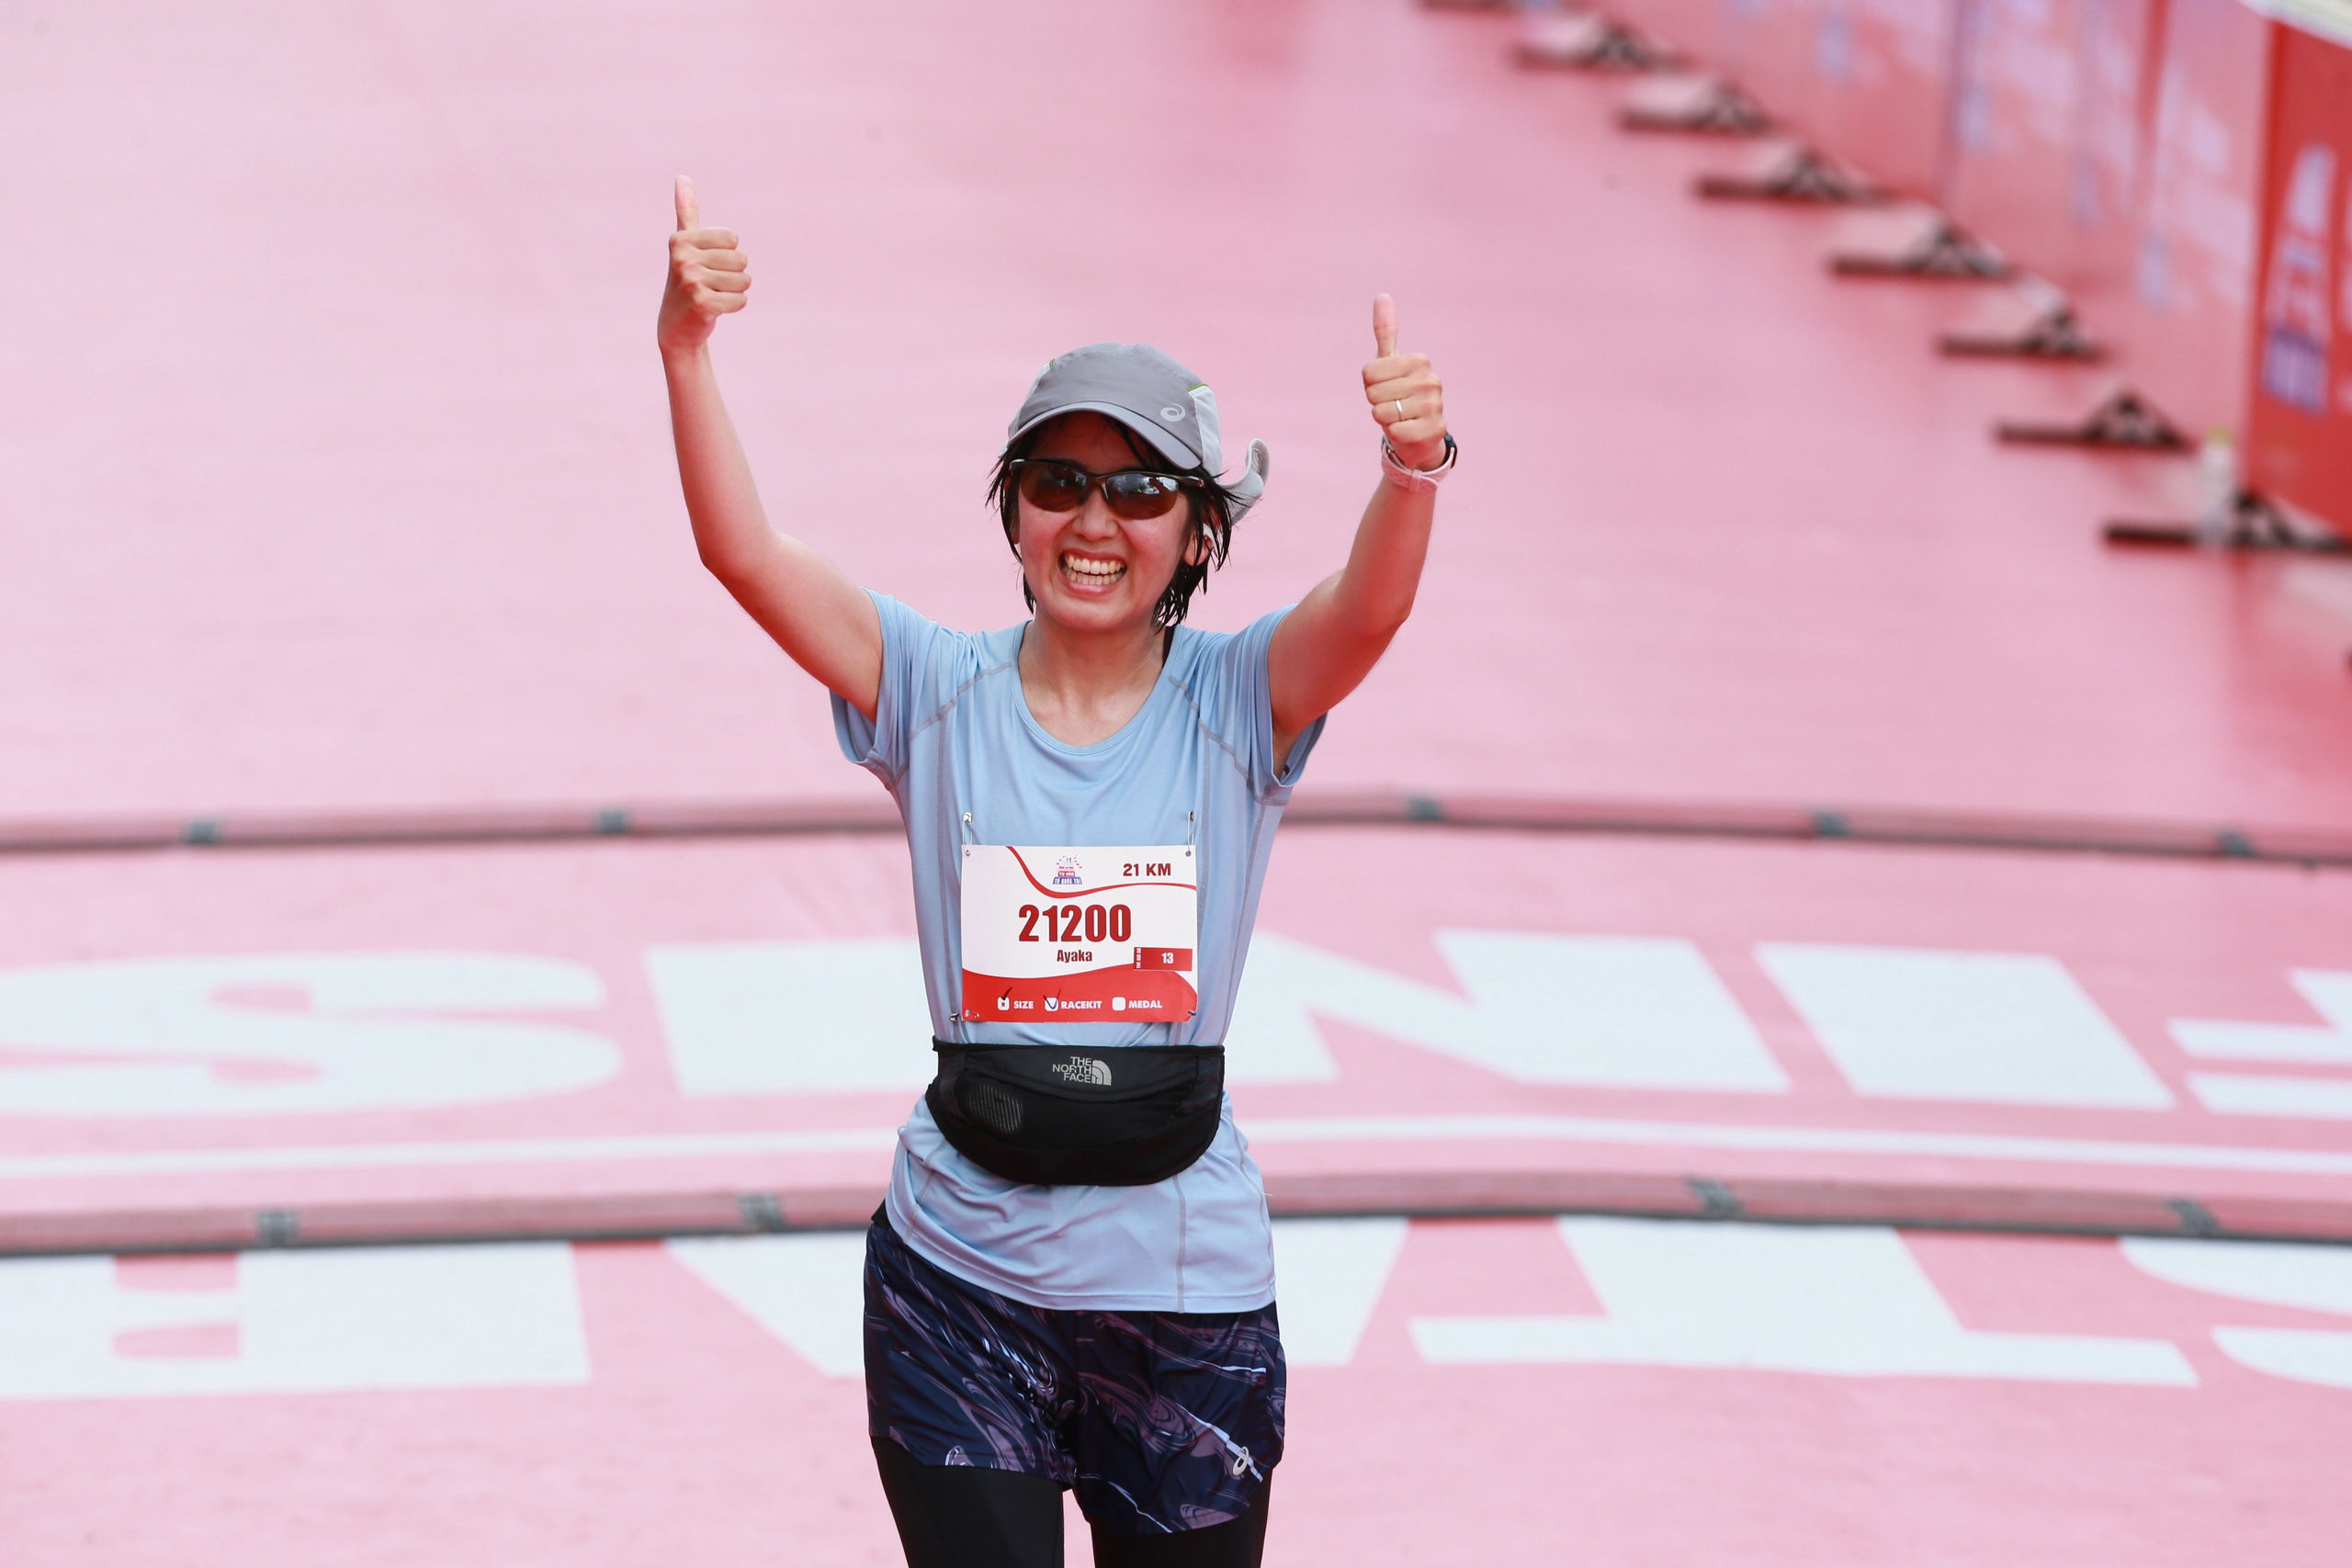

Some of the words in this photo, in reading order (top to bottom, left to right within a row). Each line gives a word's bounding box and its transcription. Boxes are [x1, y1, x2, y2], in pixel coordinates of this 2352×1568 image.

[1123, 863, 1139, 876] 21
[1146, 863, 1171, 876] KM
[1018, 904, 1132, 942] 21200
[1057, 949, 1092, 963] Ayaka
[1161, 952, 1174, 964] 13
[1013, 1000, 1034, 1010] SIZE
[1061, 999, 1102, 1010] RACEKIT
[1128, 999, 1162, 1010] MEDAL
[1070, 1056, 1092, 1066] THE
[1052, 1064, 1092, 1075] NORTH
[1063, 1072, 1091, 1084] FACE
